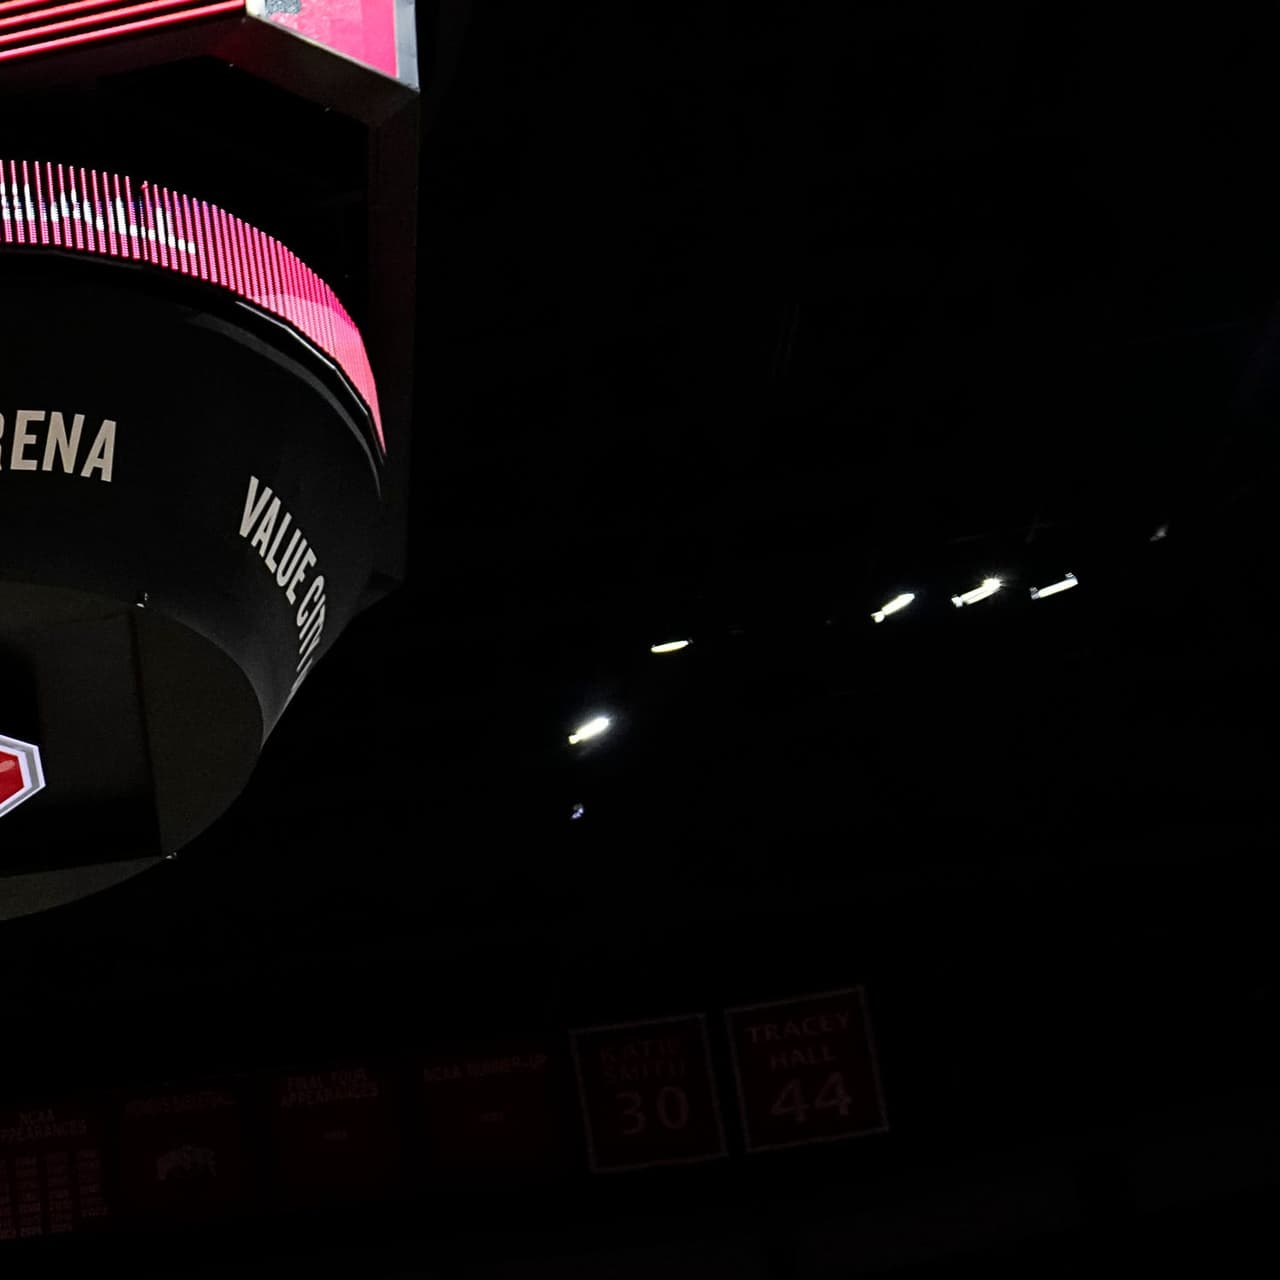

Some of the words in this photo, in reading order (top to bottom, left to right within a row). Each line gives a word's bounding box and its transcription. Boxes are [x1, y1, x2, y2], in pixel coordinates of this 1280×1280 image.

[239, 475, 317, 605] VALUE
[616, 1085, 689, 1135] 30
[768, 1072, 853, 1123] 44
